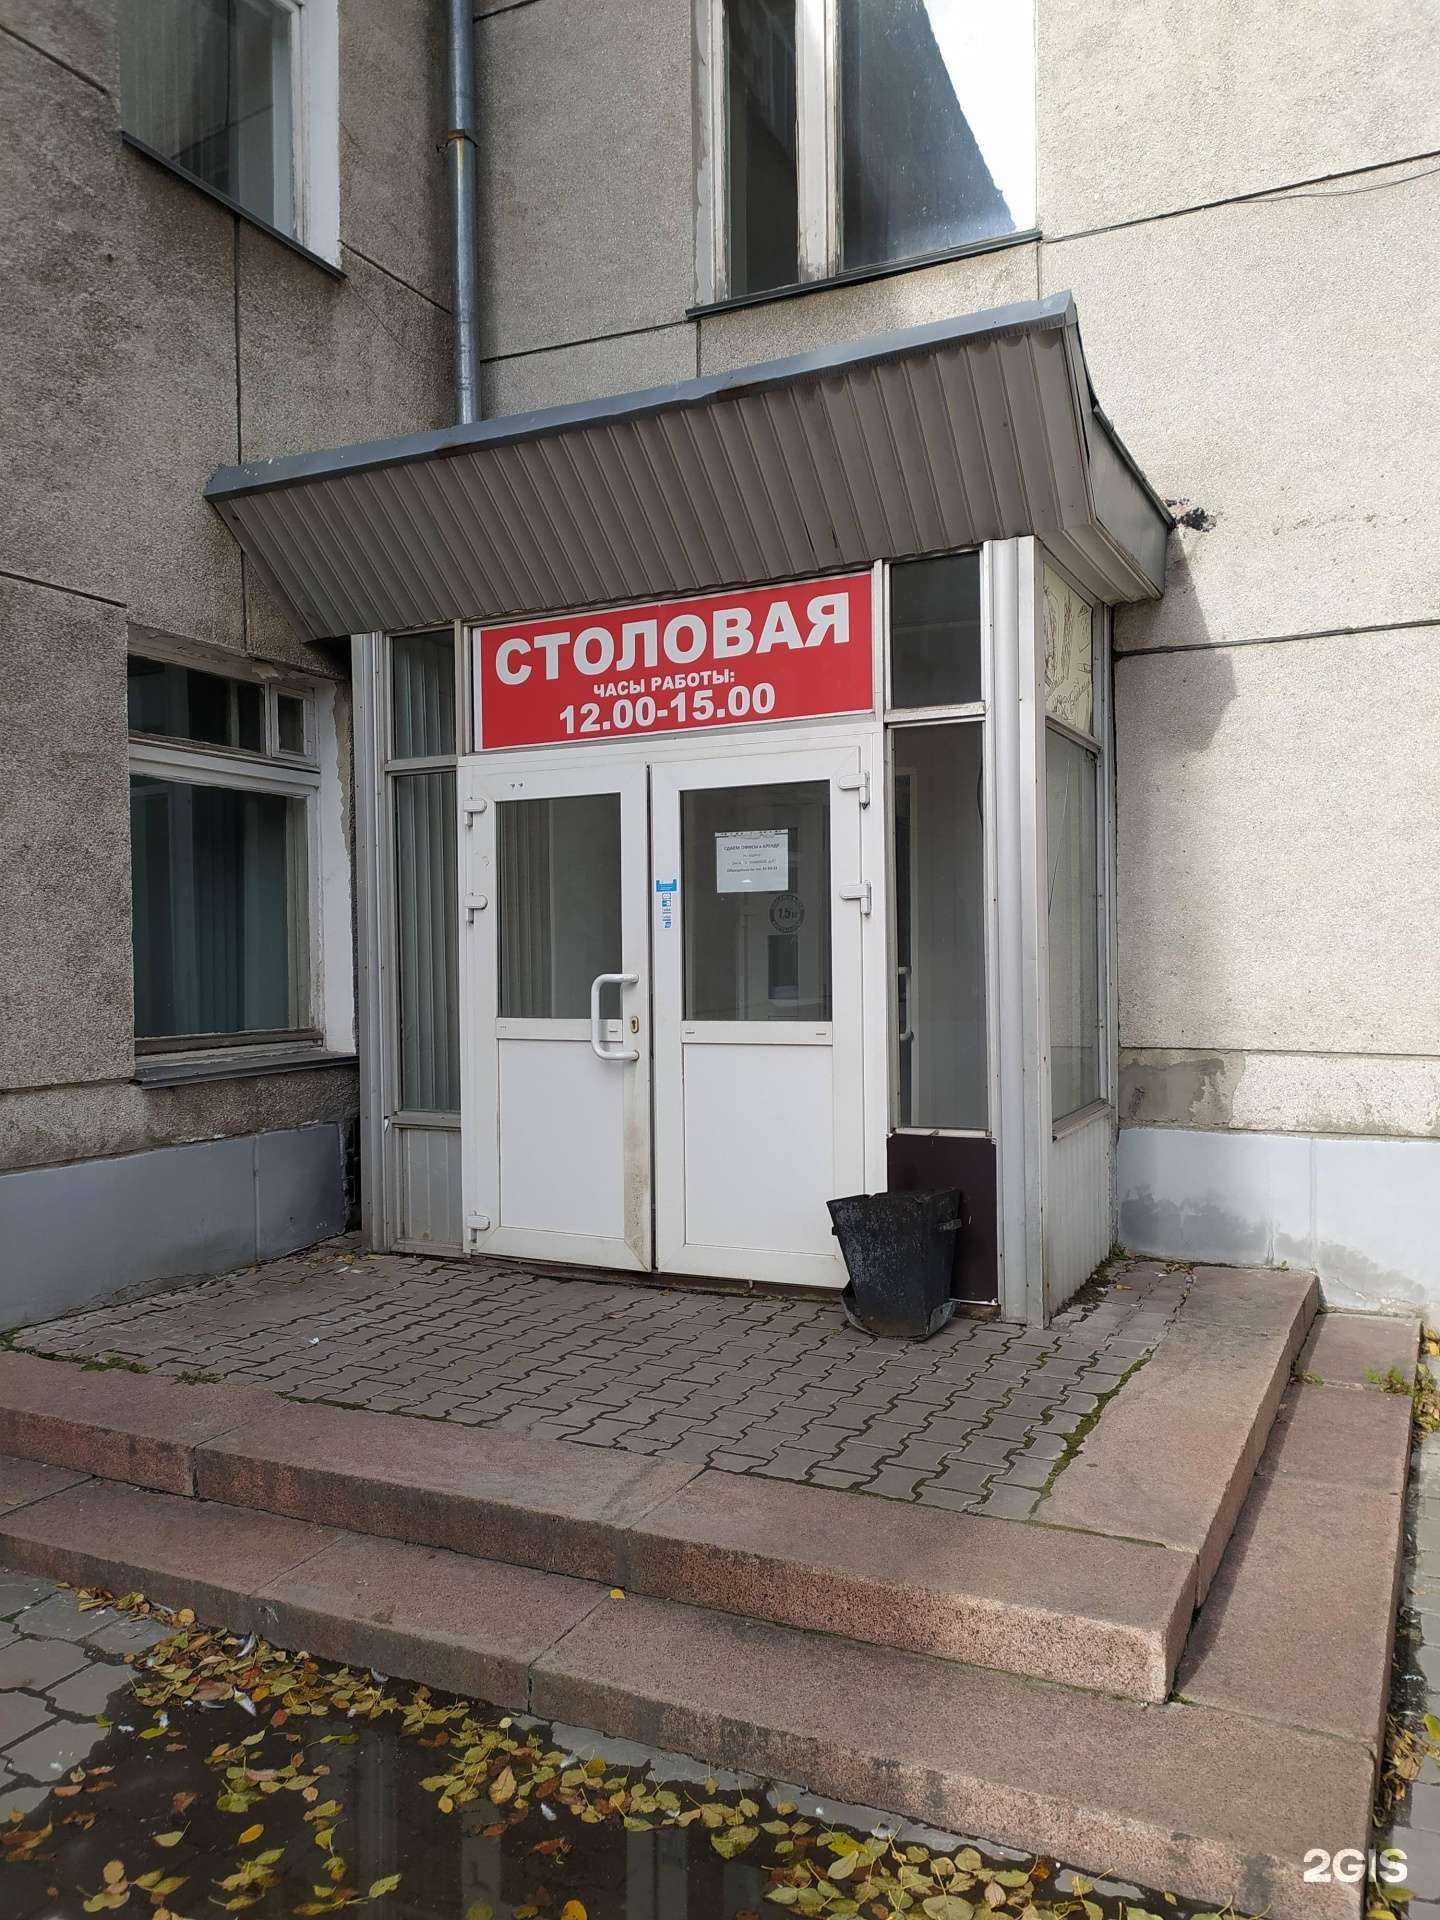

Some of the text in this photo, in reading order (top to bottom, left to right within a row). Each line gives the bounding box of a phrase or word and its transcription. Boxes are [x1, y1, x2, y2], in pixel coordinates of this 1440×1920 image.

[495, 592, 850, 686] СТОЛОВАЯ
[559, 682, 776, 735] 12.00-15.00
[593, 668, 736, 698] ЧАСЫ РАБОТЫ:
